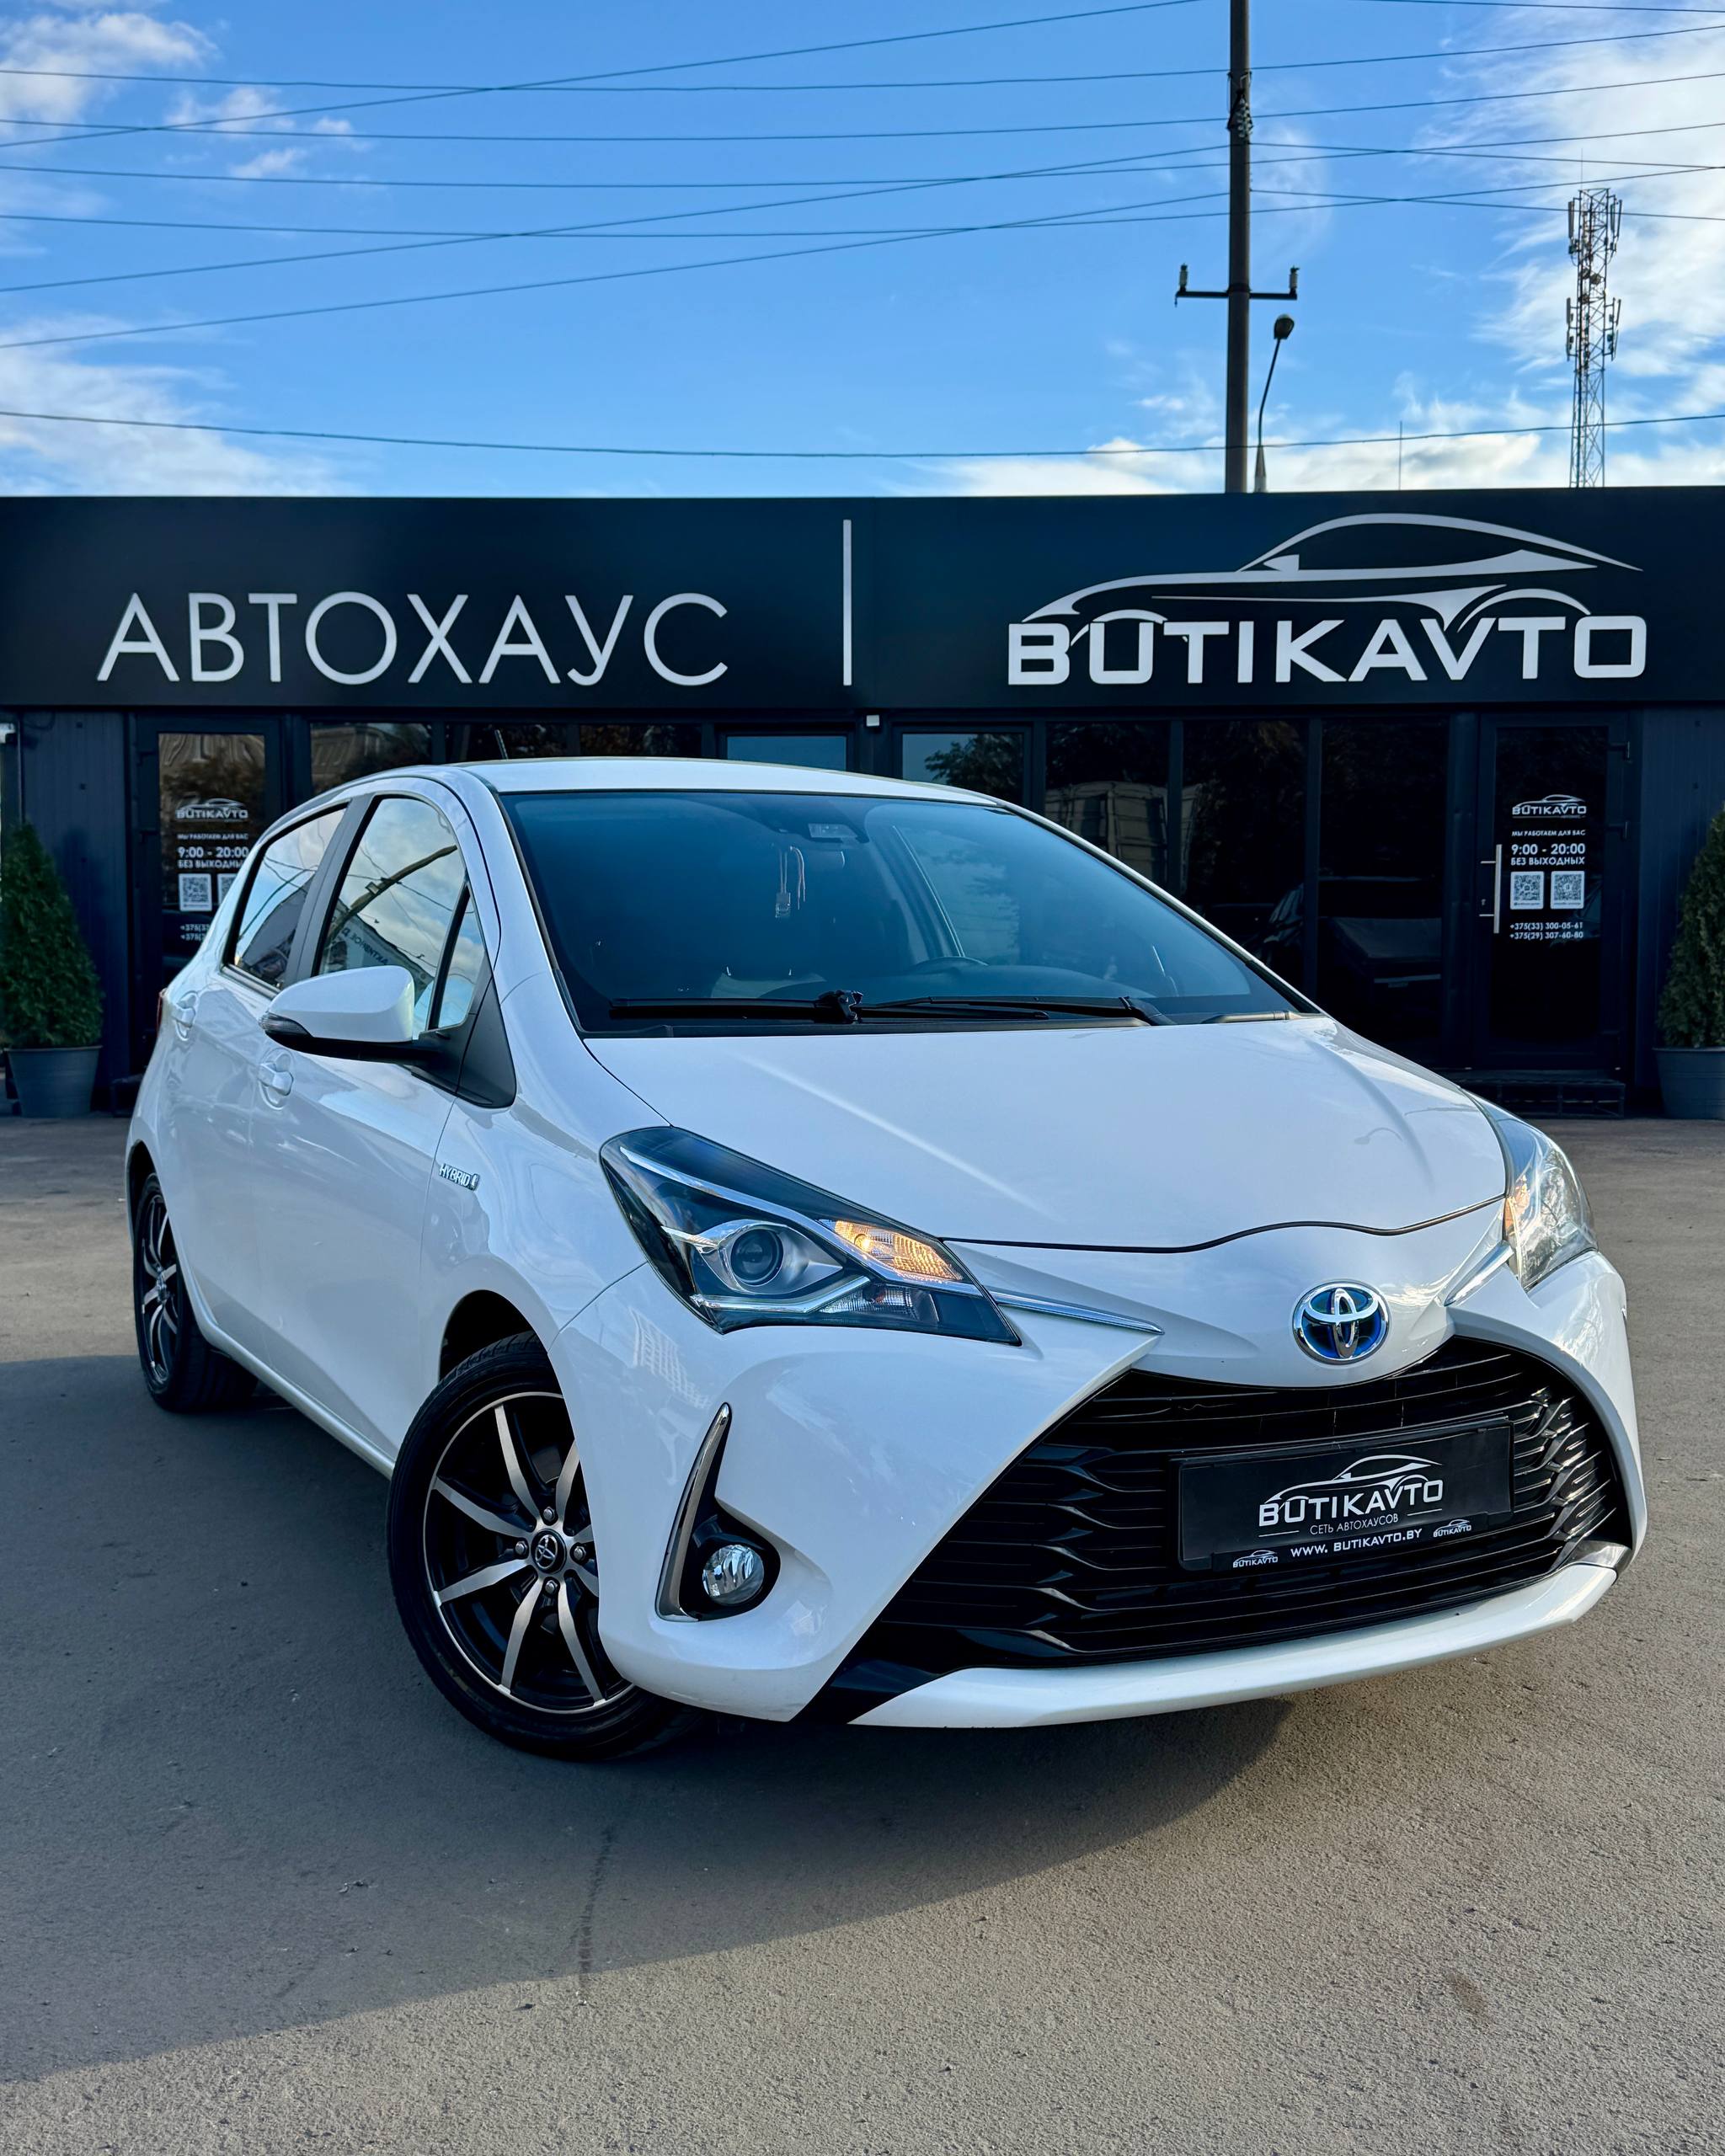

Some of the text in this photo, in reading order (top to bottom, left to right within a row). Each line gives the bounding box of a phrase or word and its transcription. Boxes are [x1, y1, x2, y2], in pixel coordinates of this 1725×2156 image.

[97, 592, 729, 686] АВТОХАУС
[1008, 615, 1648, 685] BUTIKAVTO
[176, 808, 248, 819] BUTIKAVTO
[1512, 805, 1587, 815] BUTIKAVTO
[178, 846, 204, 858] 9:00
[216, 846, 248, 858] 20:00
[1511, 844, 1538, 856] 9:00
[1551, 843, 1586, 855] 20:00
[178, 860, 244, 869] БЕЗ ВЫХОДНЫ
[1510, 857, 1585, 866] БЕЗ ВЫХОДНЫХ
[1510, 922, 1543, 931] +375(33)
[1510, 931, 1543, 941] +375(29)
[439, 1163, 471, 1187] HYBRID
[1258, 1480, 1444, 1527] BUTIKAVTO
[1310, 1513, 1399, 1535] СЕТЬ АВТОХАУСОВ
[1433, 1525, 1472, 1538] BUTIKAVTO
[1290, 1528, 1423, 1557] WWW. BUTIKAVTO.BY
[1232, 1556, 1279, 1568] BUTIKAVTO
